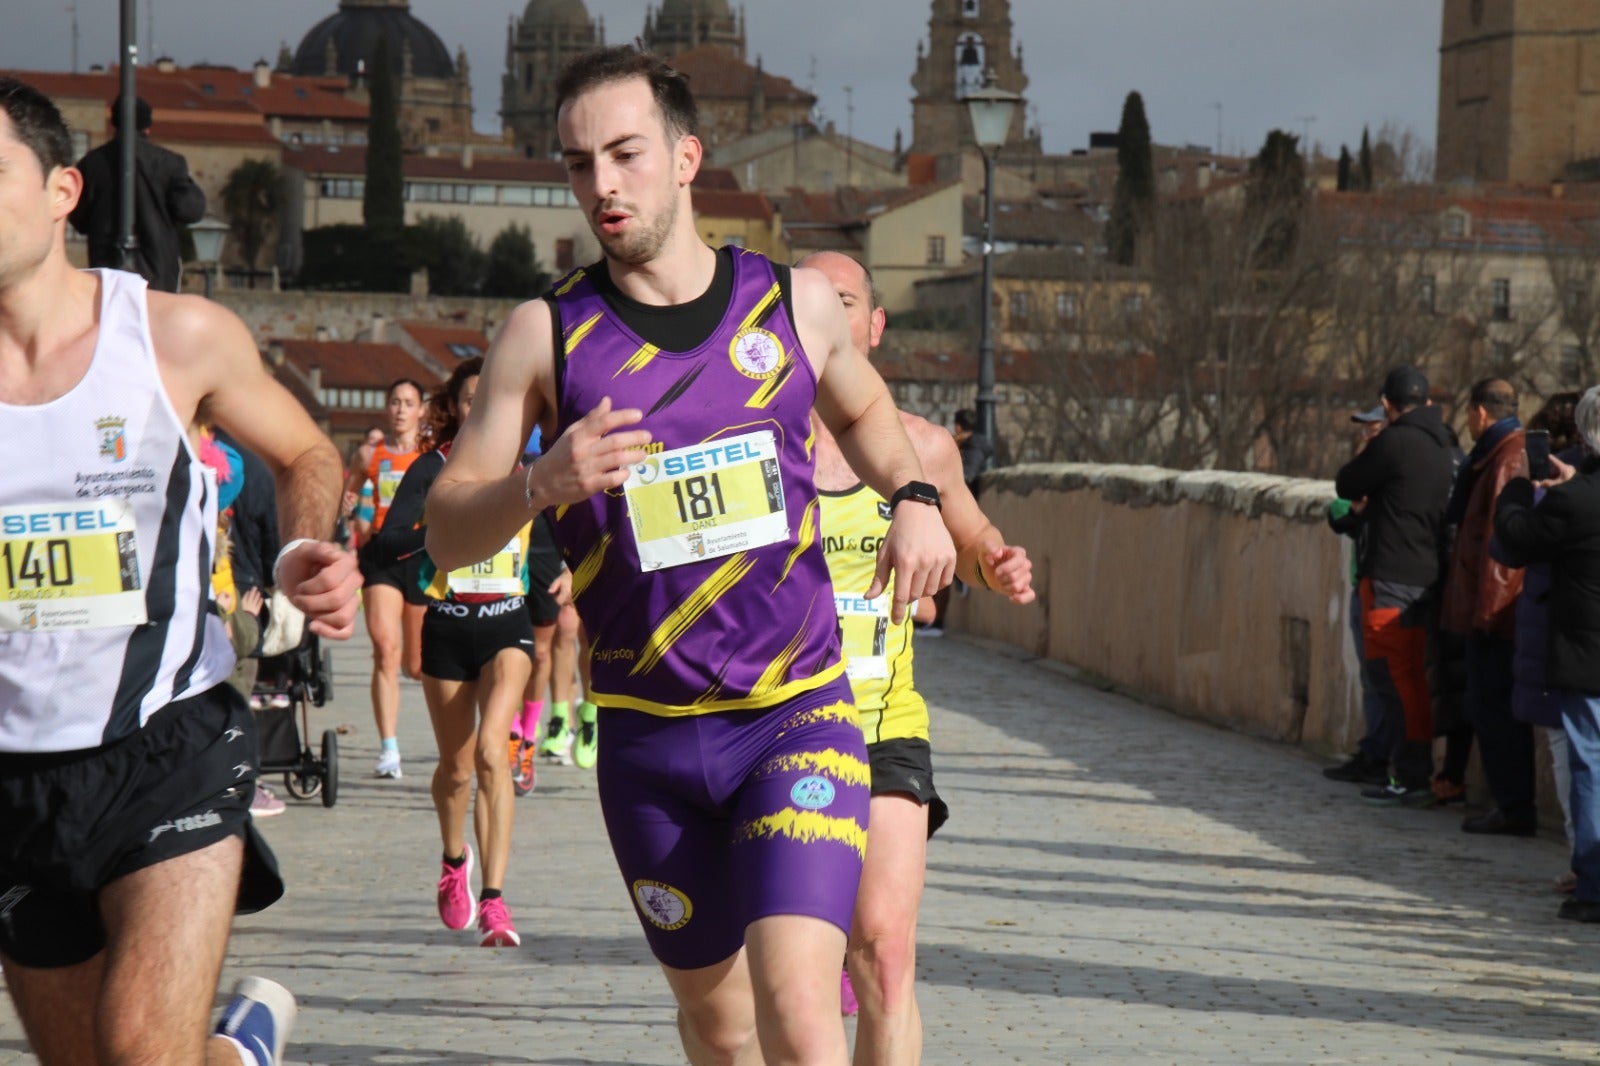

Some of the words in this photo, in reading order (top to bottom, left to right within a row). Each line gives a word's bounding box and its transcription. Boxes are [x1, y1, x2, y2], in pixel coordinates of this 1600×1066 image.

[664, 441, 761, 476] SETEL
[74, 468, 155, 485] Ayuntamiento
[75, 487, 89, 498] de
[673, 472, 726, 522] 181
[3, 510, 117, 535] SETEL
[692, 517, 717, 531] DANI
[847, 538, 857, 550] &
[2, 540, 73, 589] 140
[8, 589, 51, 600] CARLOS
[430, 600, 469, 617] PRO
[478, 596, 520, 618] NIKE
[834, 598, 878, 612] TEL
